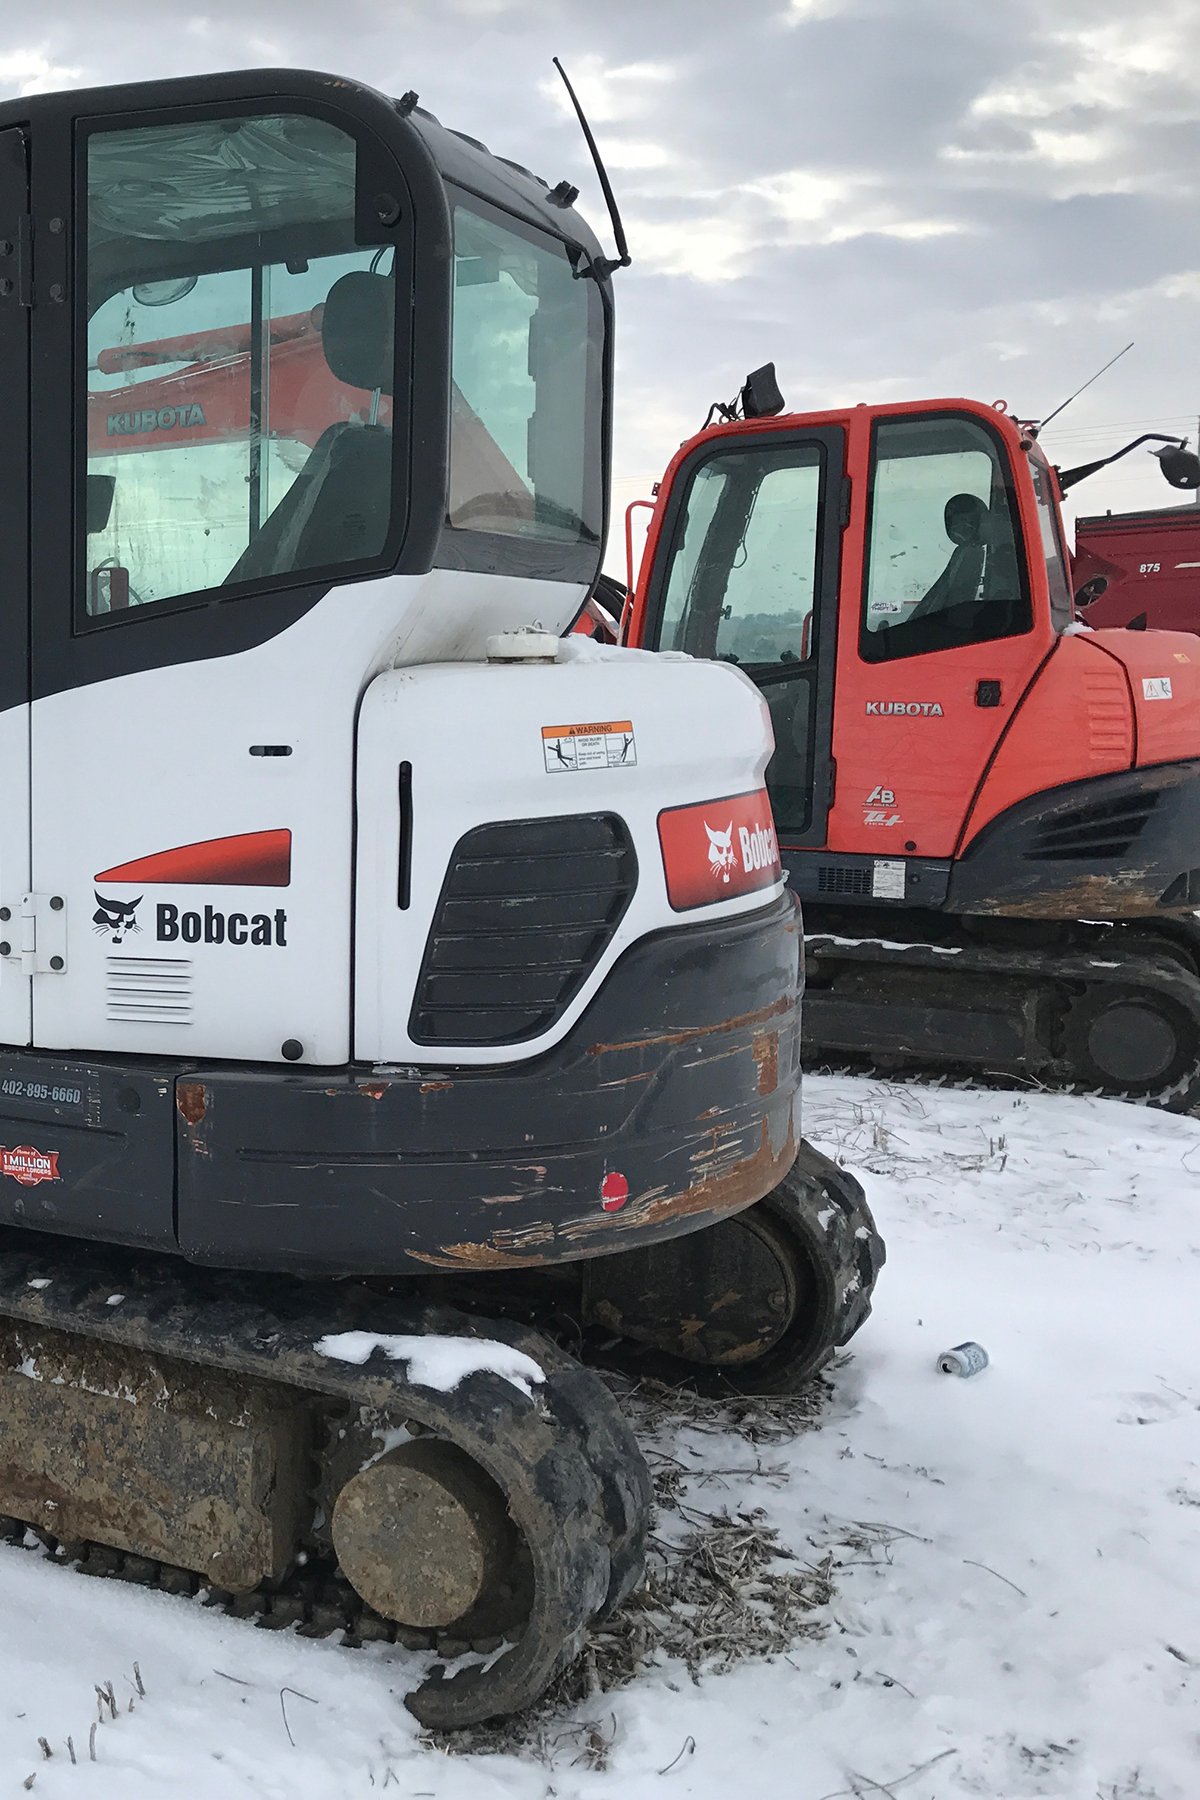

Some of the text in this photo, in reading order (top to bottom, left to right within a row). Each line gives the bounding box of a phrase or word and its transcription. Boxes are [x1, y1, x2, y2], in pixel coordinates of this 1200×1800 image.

[106, 403, 207, 436] KUBOTA
[1139, 563, 1161, 573] 875
[865, 701, 944, 716] KUBOTA
[575, 724, 613, 734] WARNING
[156, 903, 287, 946] Bobcat
[1, 1079, 81, 1104] 402-895-6660
[3, 1154, 51, 1169] 1 MILLION
